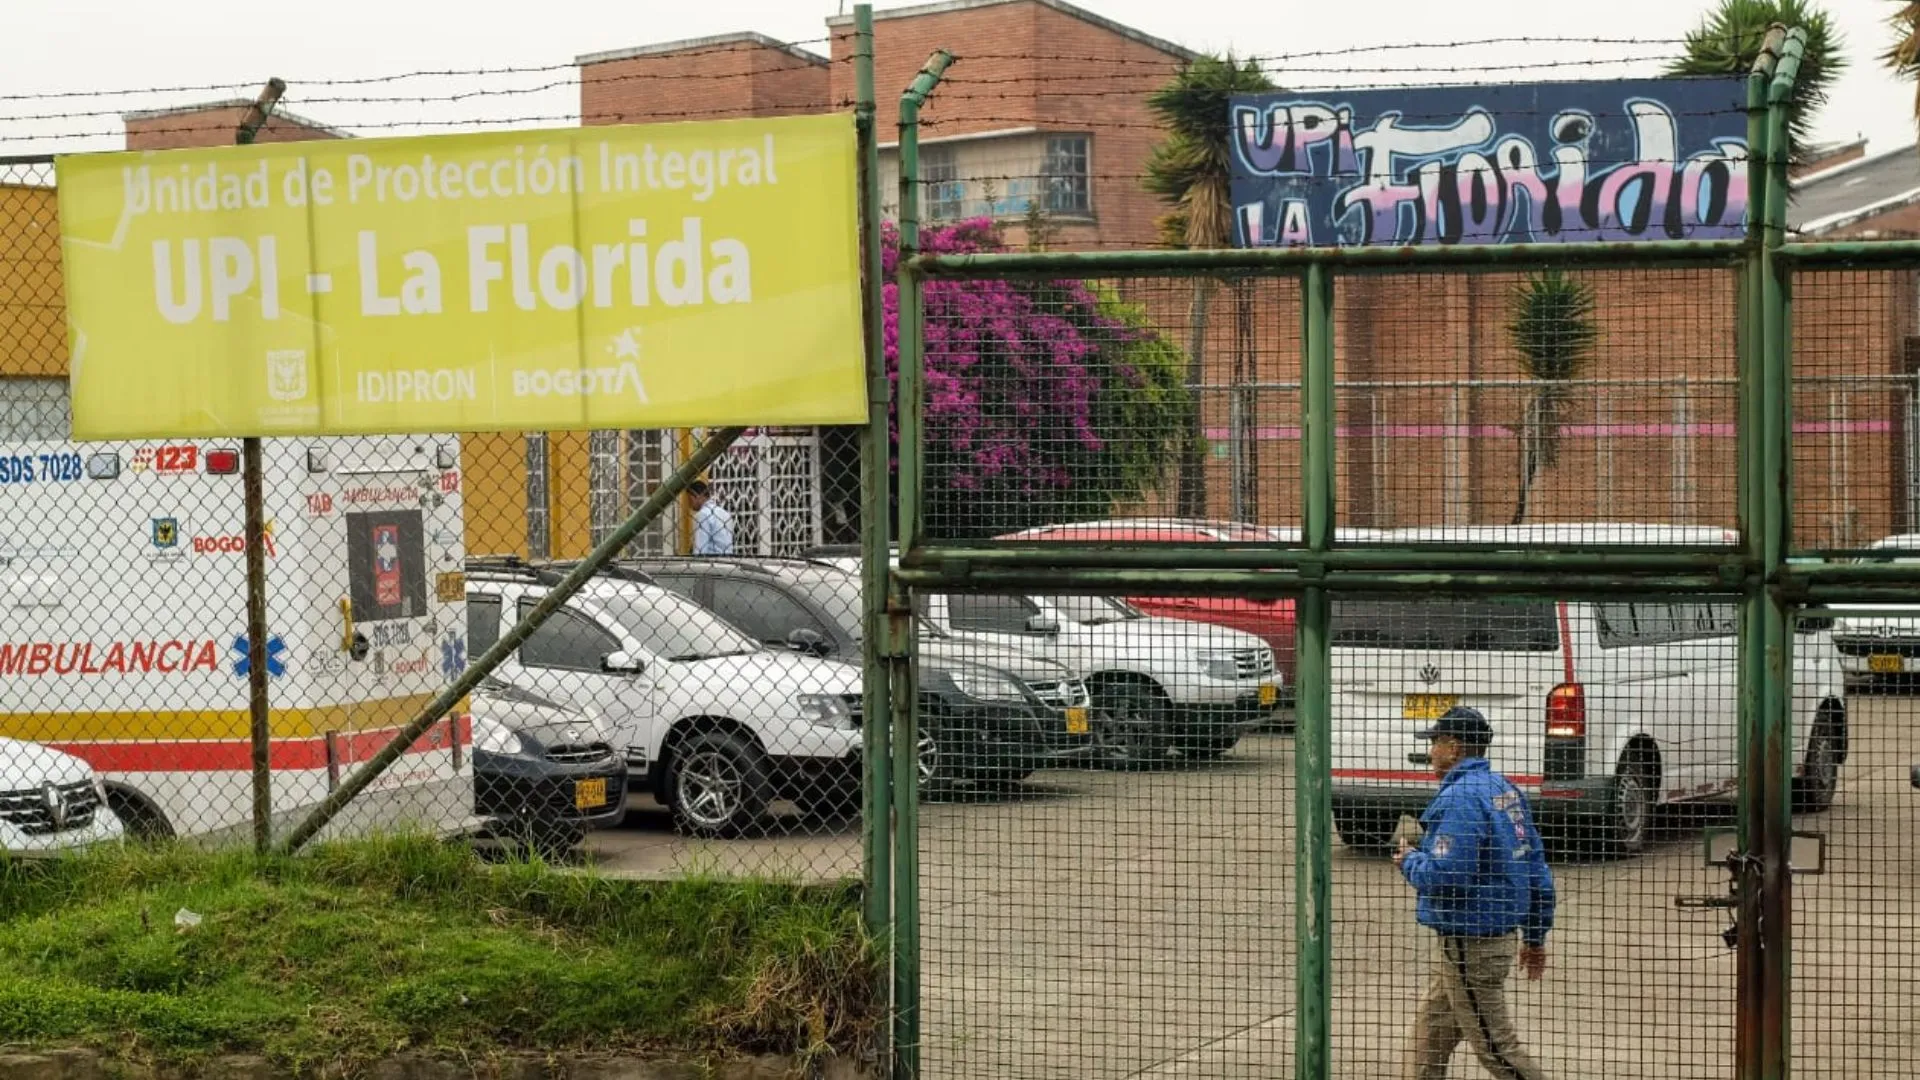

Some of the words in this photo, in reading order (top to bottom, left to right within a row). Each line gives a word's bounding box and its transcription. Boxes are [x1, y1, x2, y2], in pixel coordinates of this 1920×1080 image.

[282, 157, 334, 206] de
[346, 144, 584, 201] Protección
[600, 133, 778, 202] Integral
[1237, 198, 1314, 247] LA
[152, 234, 280, 324] UPI
[305, 273, 333, 293] -
[358, 230, 443, 317] La
[467, 216, 752, 313] Florida
[357, 368, 477, 403] IDIPRON
[0, 455, 36, 484] SDS
[39, 452, 83, 481] 7028
[155, 445, 198, 471] 123
[441, 472, 459, 492] 123
[194, 530, 276, 558] BOGO
[0, 639, 217, 675] MBULANCIA
